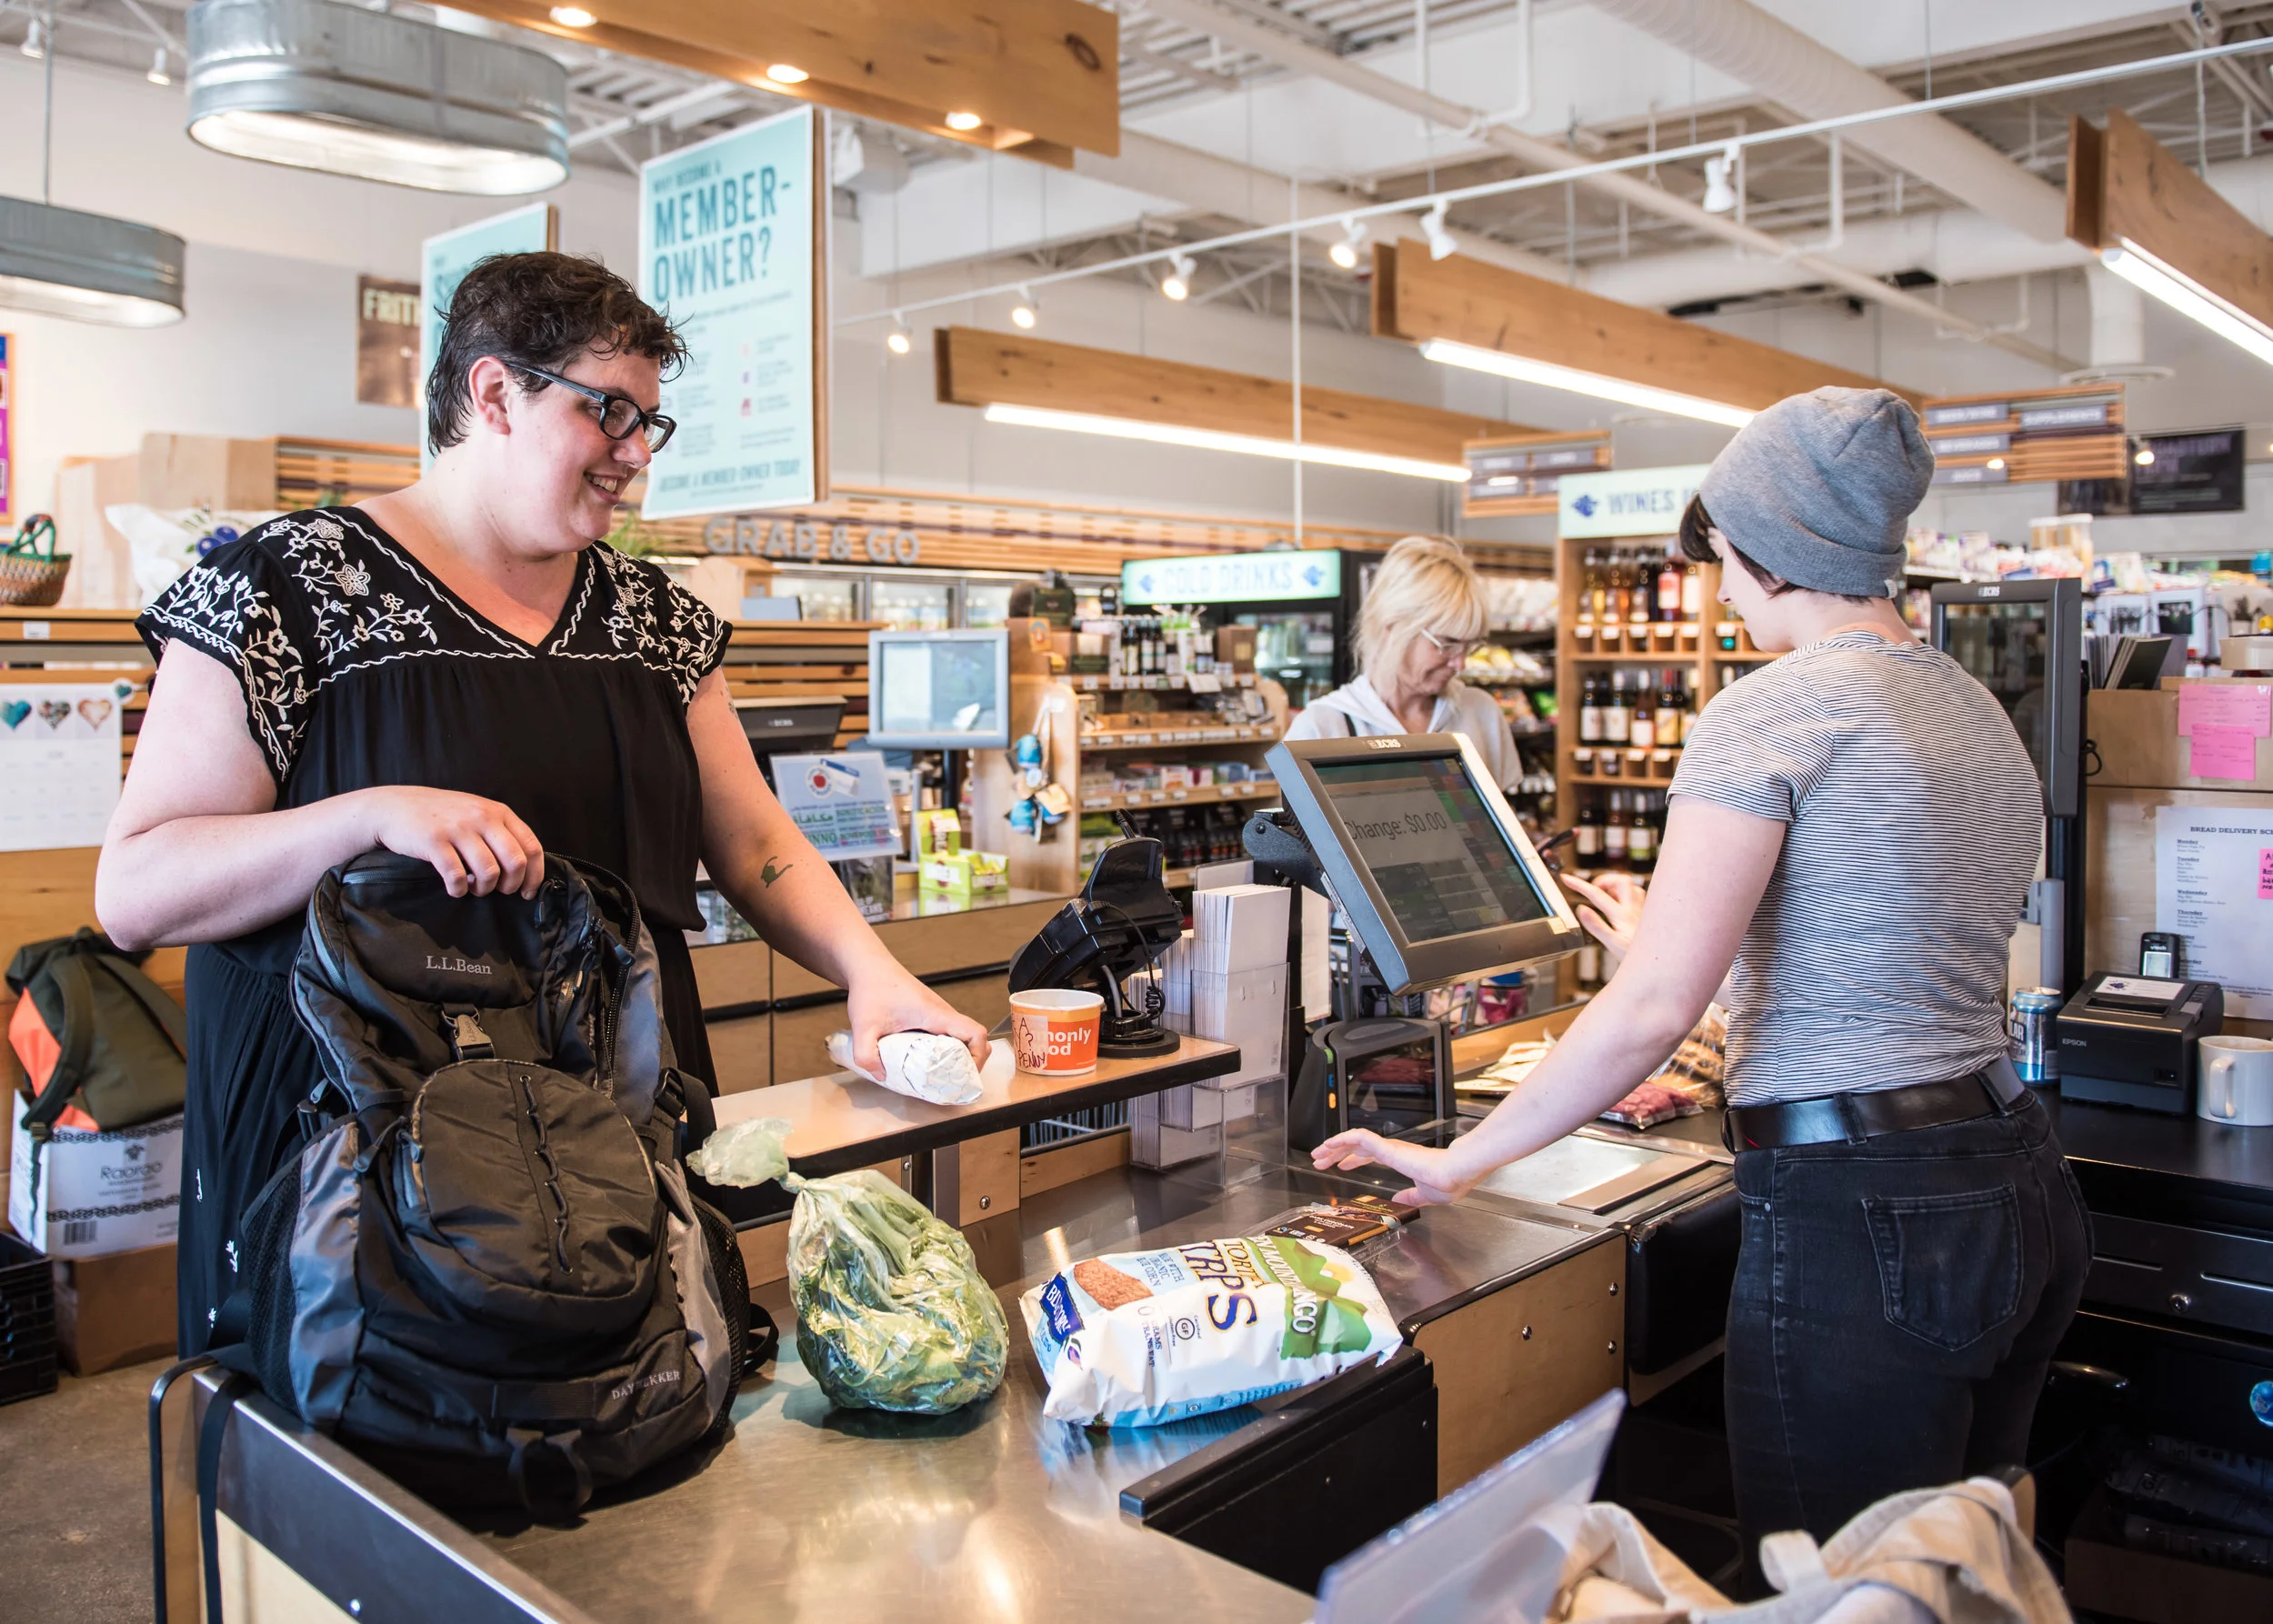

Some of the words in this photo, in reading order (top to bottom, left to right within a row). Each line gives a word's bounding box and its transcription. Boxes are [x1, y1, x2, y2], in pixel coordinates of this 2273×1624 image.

[656, 165, 791, 248] MEMBER-
[654, 226, 771, 303] OWNER?
[1607, 488, 1676, 516] WINES
[705, 516, 817, 558] GRAB
[829, 524, 853, 560] &
[866, 526, 920, 565] GO
[1164, 565, 1211, 596] COLD
[1219, 561, 1293, 593] DRINKS
[1344, 817, 1407, 841] Change:
[1404, 811, 1447, 836] $0.00
[2218, 827, 2258, 835] DELIVERY
[426, 955, 493, 975] L.L.Bean
[2061, 1038, 2088, 1047] EPSON
[1018, 1049, 1046, 1068] PENNY
[1181, 1321, 1189, 1336] GF
